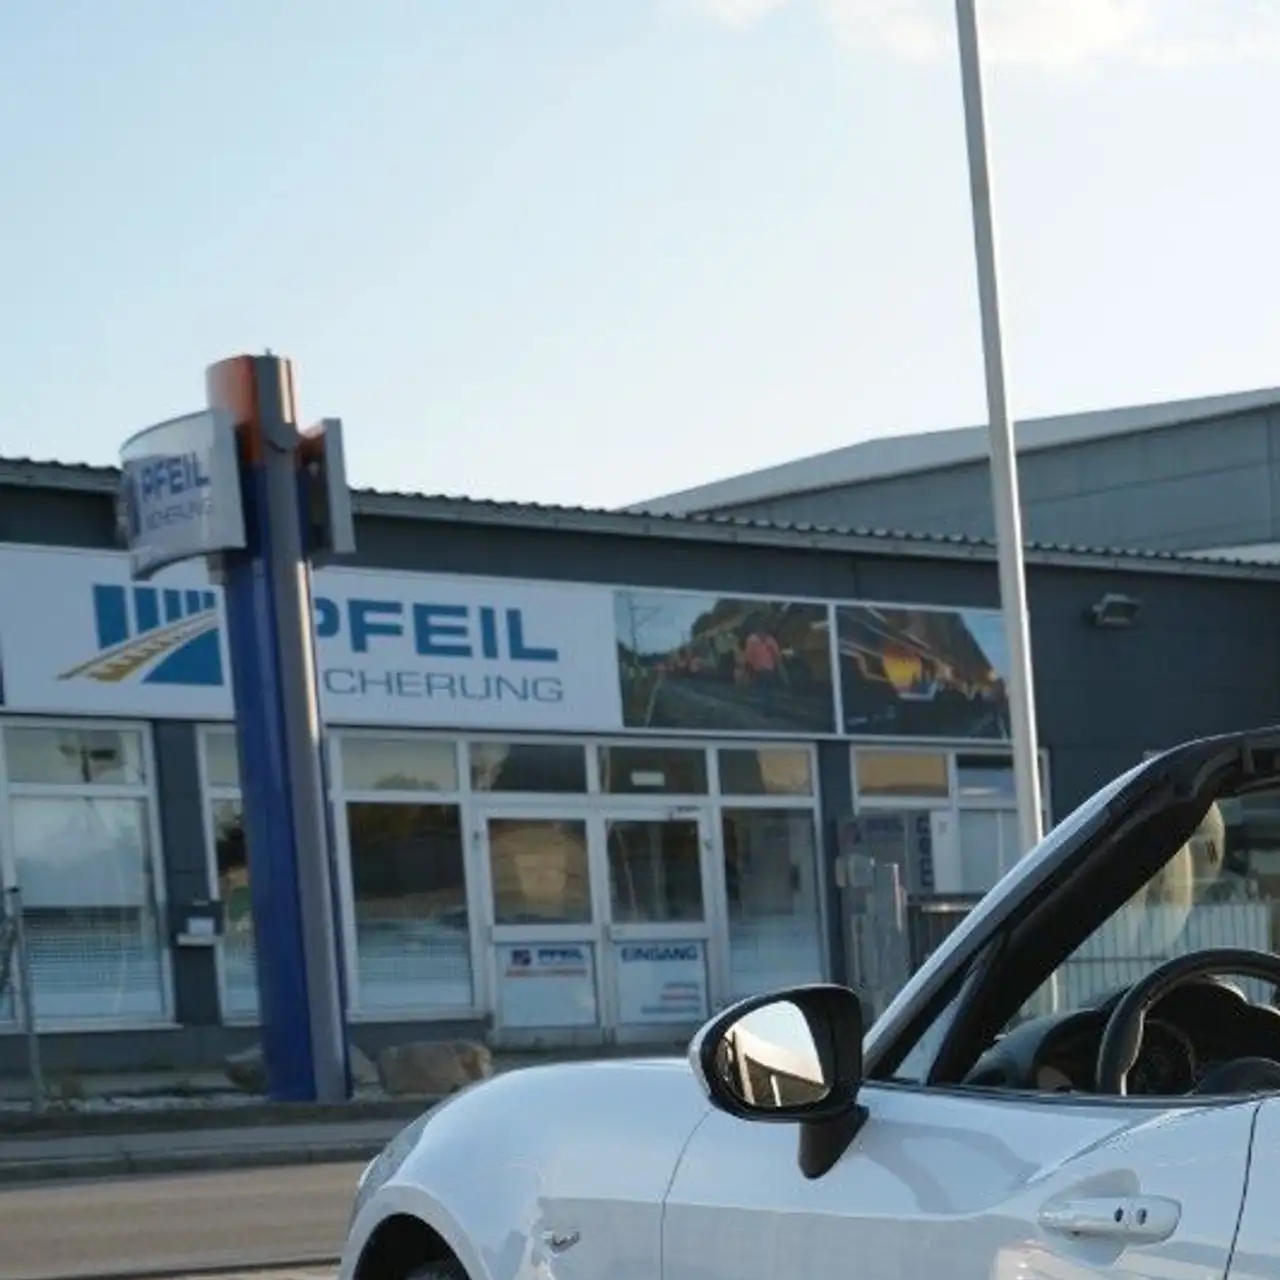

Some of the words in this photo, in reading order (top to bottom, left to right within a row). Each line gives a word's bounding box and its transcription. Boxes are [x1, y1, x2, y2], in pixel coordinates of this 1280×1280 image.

[141, 451, 210, 503] PFEIL
[322, 667, 565, 703] CHERUNG
[620, 945, 699, 963] EINGANG
